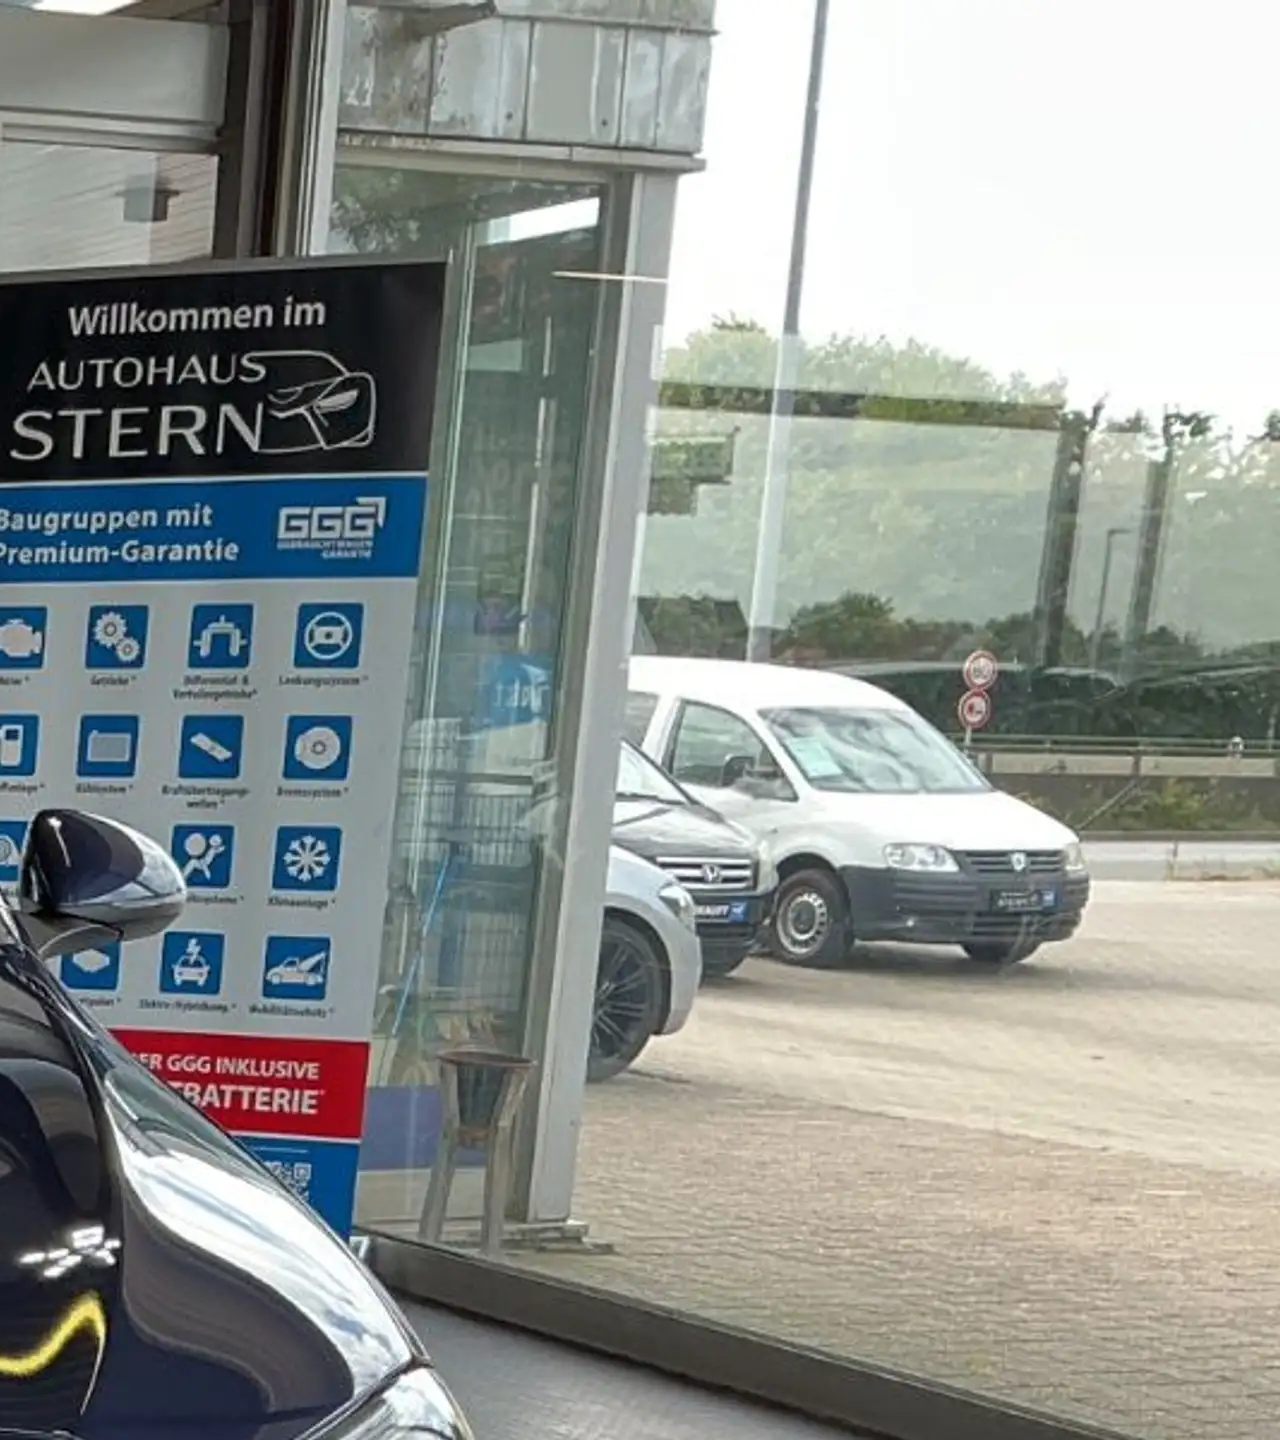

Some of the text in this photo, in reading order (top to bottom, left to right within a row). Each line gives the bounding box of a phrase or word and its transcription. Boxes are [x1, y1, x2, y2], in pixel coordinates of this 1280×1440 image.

[68, 297, 326, 337] Willkommen im
[27, 353, 267, 393] AUTOHAUS
[10, 402, 264, 461] STERN
[166, 503, 212, 528] mit
[276, 505, 375, 540] GGG
[167, 1054, 211, 1074] GGG
[216, 1056, 321, 1080] INKLUSIVE
